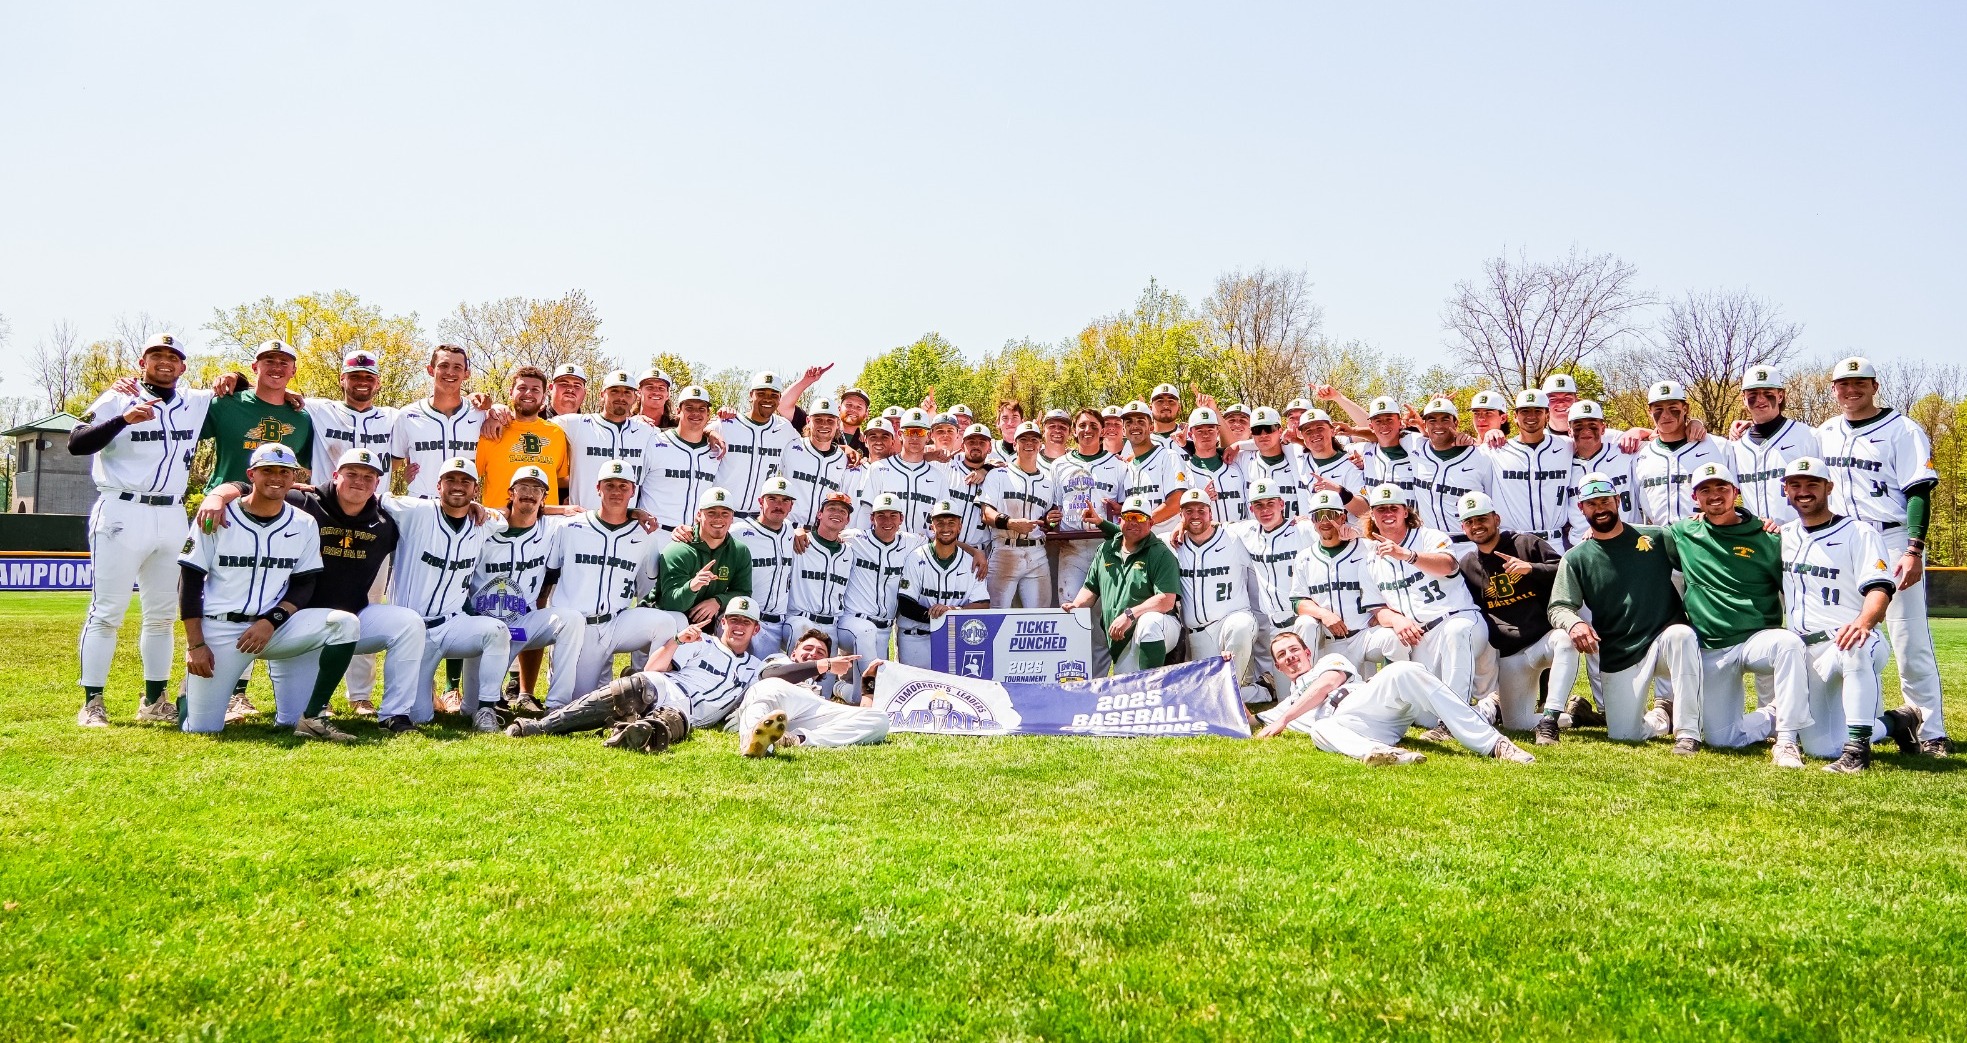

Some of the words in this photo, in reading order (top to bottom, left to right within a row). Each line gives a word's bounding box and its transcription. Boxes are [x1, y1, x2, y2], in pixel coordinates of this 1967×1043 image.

[325, 428, 391, 444] BROCKPORT
[728, 444, 782, 458] BROCKPORT
[509, 455, 553, 465] BASEBALL
[1824, 456, 1882, 472] ROCKPORT
[665, 468, 716, 482] BROCKPOR
[793, 470, 840, 492] BROCKPOR
[1503, 470, 1567, 481] BROCKPORT
[1643, 474, 1692, 488] BROCKP
[1737, 468, 1786, 484] ROCKPOR
[219, 556, 300, 569] BROCKPORT
[421, 551, 476, 571] BROCKPORT
[486, 555, 545, 574] BROCKPORT
[575, 554, 636, 572] BROCKPORT
[1216, 582, 1232, 602] 21
[1309, 582, 1360, 595] ROCKPOR
[1419, 580, 1446, 604] 33
[1487, 592, 1537, 609] BASEBALL
[1016, 621, 1058, 634] TICKET
[1010, 637, 1067, 650] PUNCHED
[956, 690, 987, 714] LEADERS
[1095, 690, 1163, 712] 2025
[1071, 704, 1193, 728] BASEBALL
